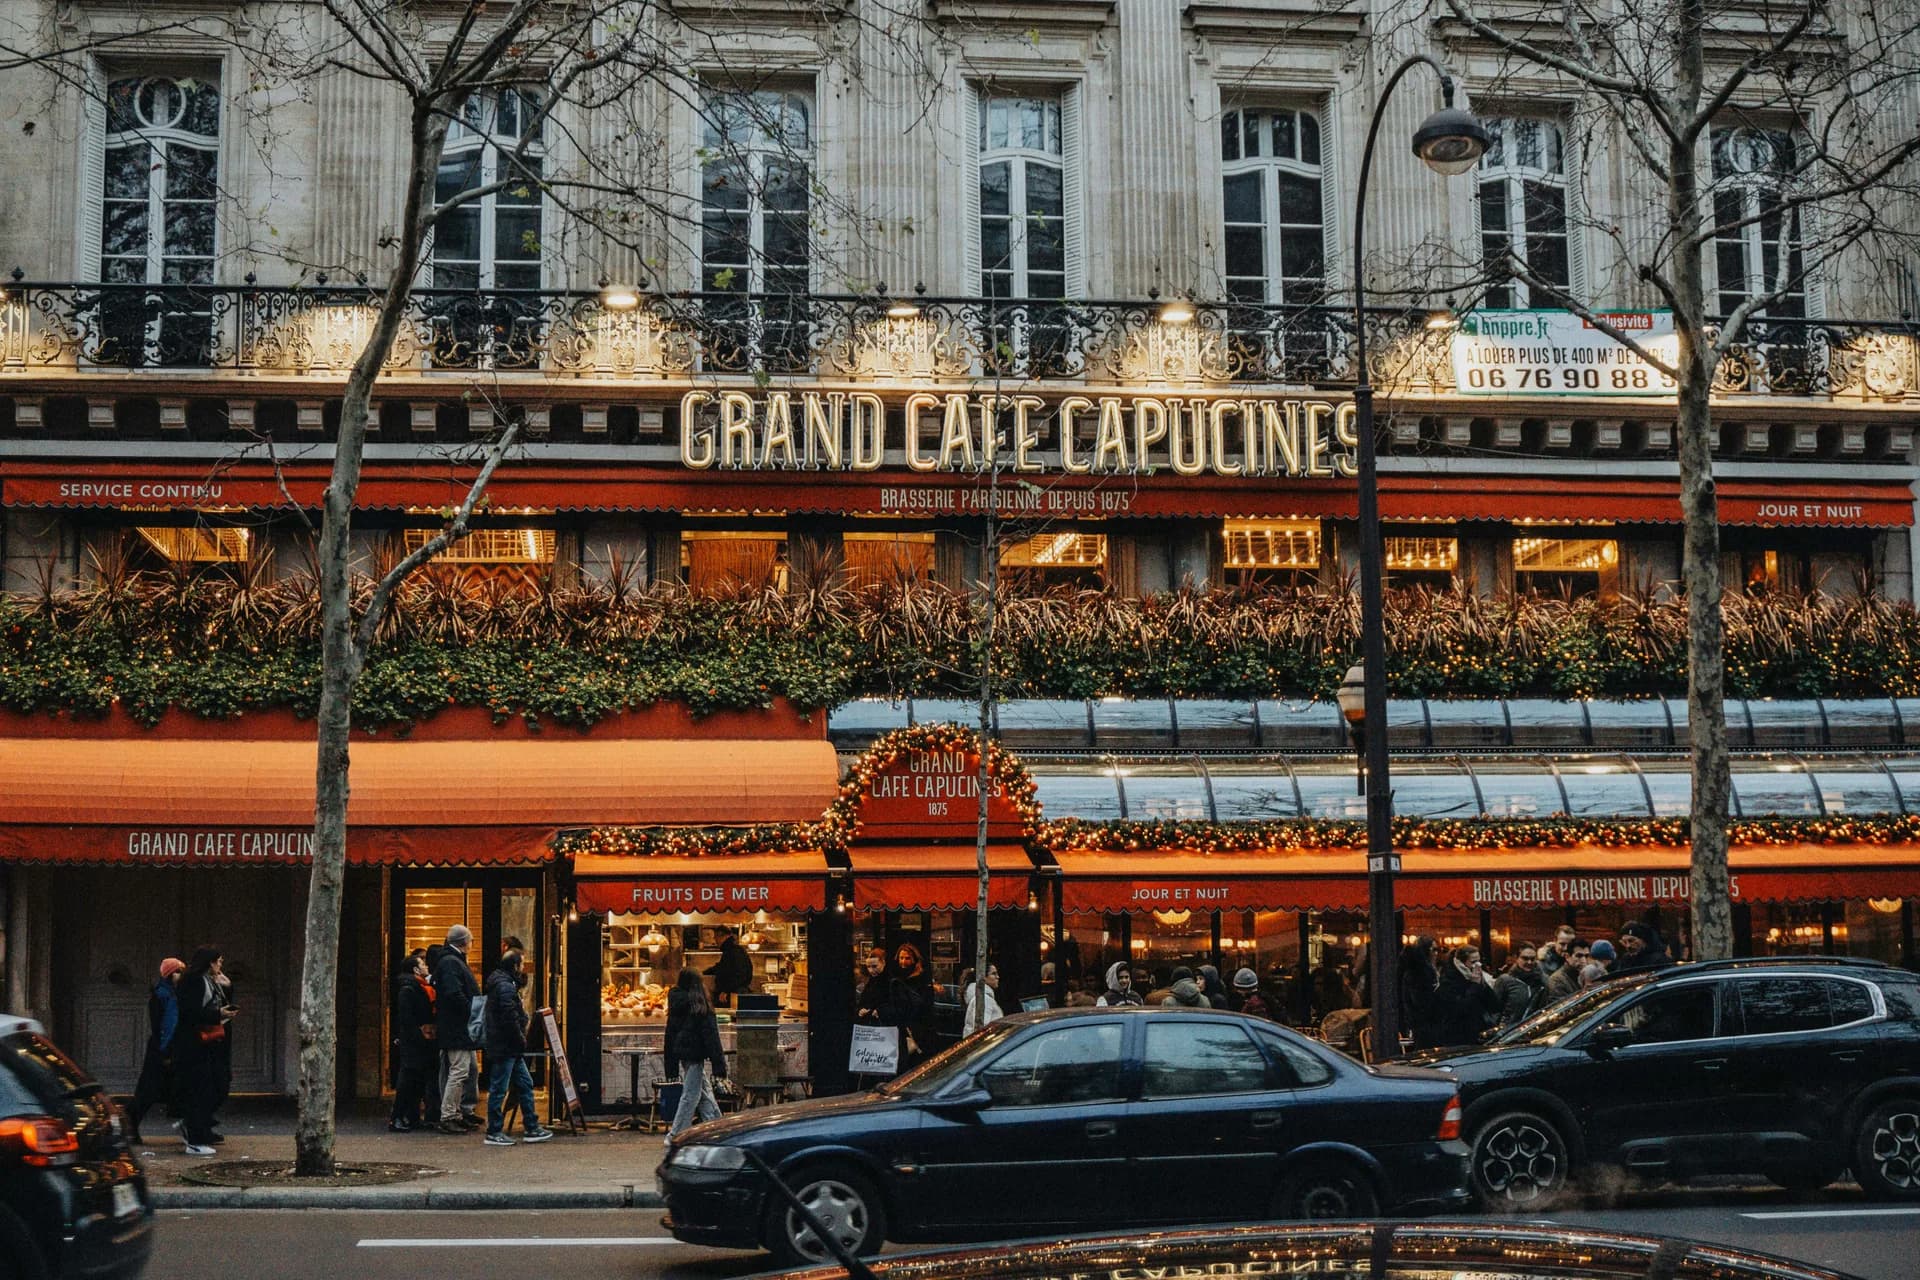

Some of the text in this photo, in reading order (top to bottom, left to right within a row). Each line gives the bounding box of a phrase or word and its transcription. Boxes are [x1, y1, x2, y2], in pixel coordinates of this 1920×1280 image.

[1481, 316, 1549, 339] bnppre.fr
[1478, 347, 1515, 364] LOUER
[1519, 347, 1549, 364] PLUS
[1553, 347, 1569, 364] DE
[1571, 347, 1594, 364] 400
[1617, 347, 1631, 364] DE
[1468, 368, 1506, 388] 06
[1515, 368, 1552, 388] 76
[1562, 368, 1600, 389] 90
[1610, 369, 1649, 389] 88
[680, 390, 1359, 476] GRAND CAFE CAPUCINES
[60, 484, 222, 498] SERVICE CONTINU
[881, 489, 1129, 511] BRASSERIE PARISIENNE DEPUIS 1875
[1757, 505, 1863, 518] JOUR ET NUIT
[910, 751, 965, 773] GRAND
[872, 775, 910, 798] CAFE
[928, 803, 948, 815] 1875
[129, 832, 314, 856] GRAND CAFE CAPUCIN
[633, 887, 769, 901] FRUITS DE MER
[1132, 888, 1230, 900] JOUR ET NUIT
[1473, 877, 1690, 902] BRASSERIE PARISIENNE DEPU
